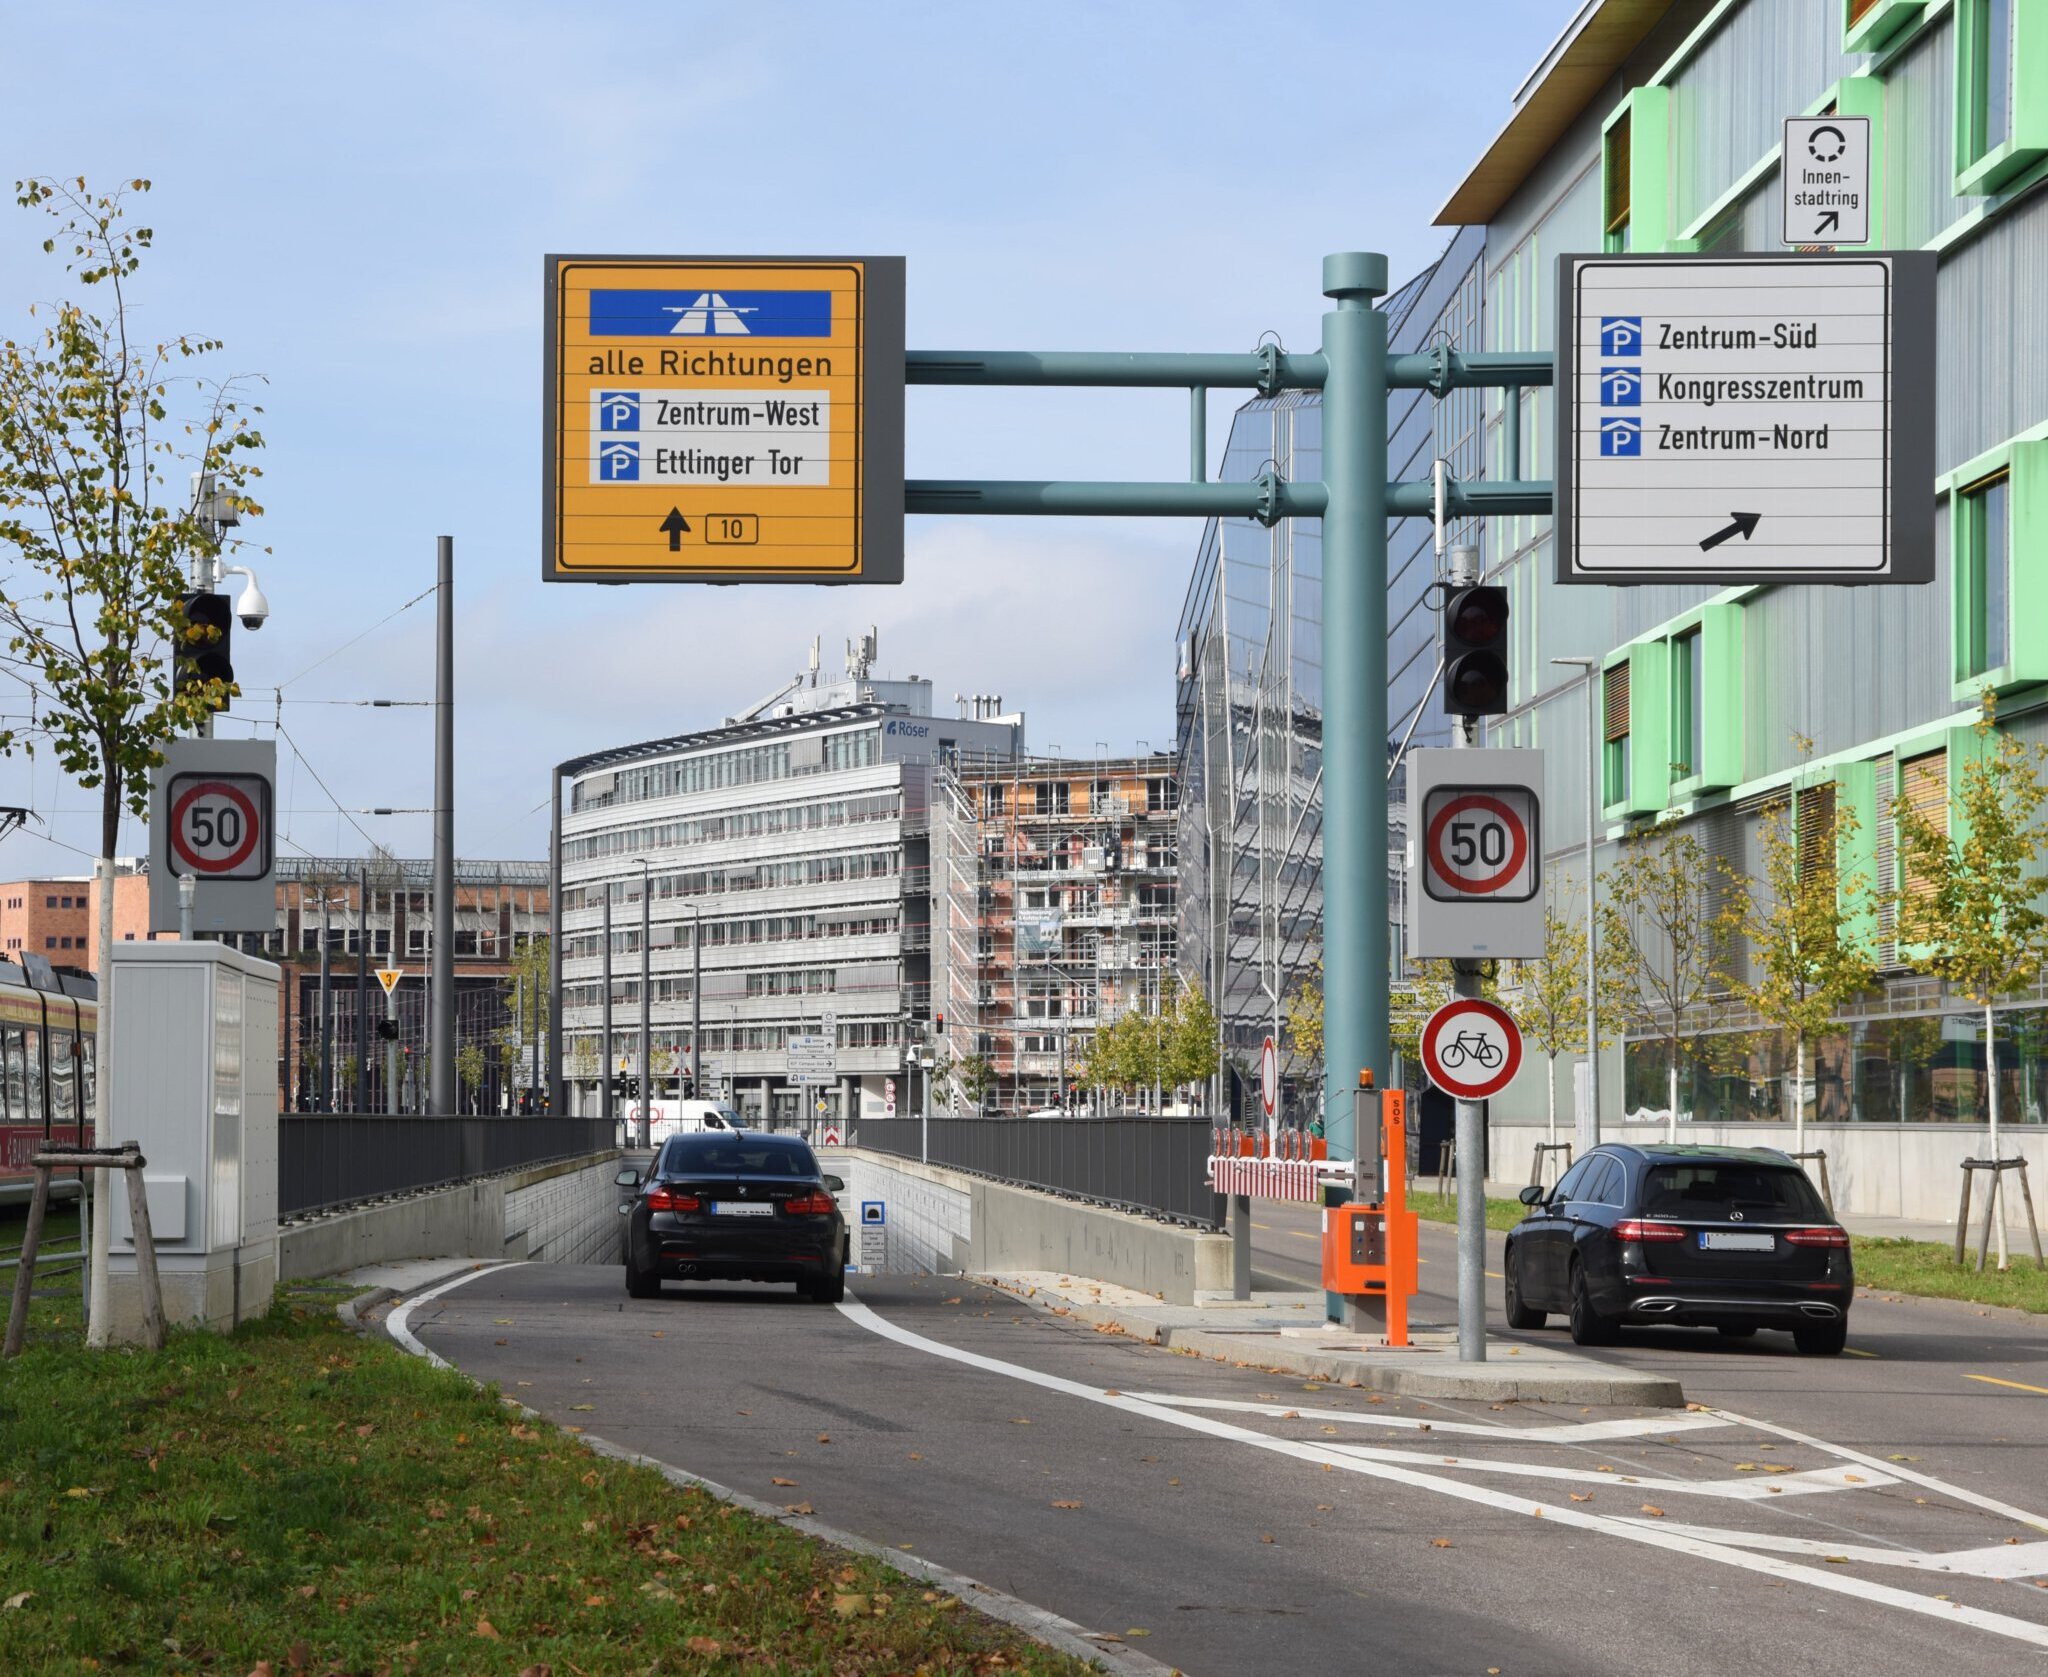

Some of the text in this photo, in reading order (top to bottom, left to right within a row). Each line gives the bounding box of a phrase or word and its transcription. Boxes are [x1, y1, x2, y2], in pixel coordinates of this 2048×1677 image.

[1802, 168, 1850, 185] Innen-
[1794, 190, 1859, 209] stadtring
[1659, 323, 1818, 350] Zentrum-Süd
[588, 349, 832, 384] alle Richtungen
[1658, 373, 1864, 406] Kongresszentrum
[657, 399, 819, 426] Zentrum-West
[1658, 424, 1829, 450] Zentrum-Nord
[656, 448, 755, 482] Ettlinger
[768, 449, 803, 475] Tor
[721, 519, 743, 539] 10
[899, 721, 929, 738] Röser
[192, 807, 240, 848] 50
[1451, 822, 1506, 866] 50
[385, 974, 392, 987] 3
